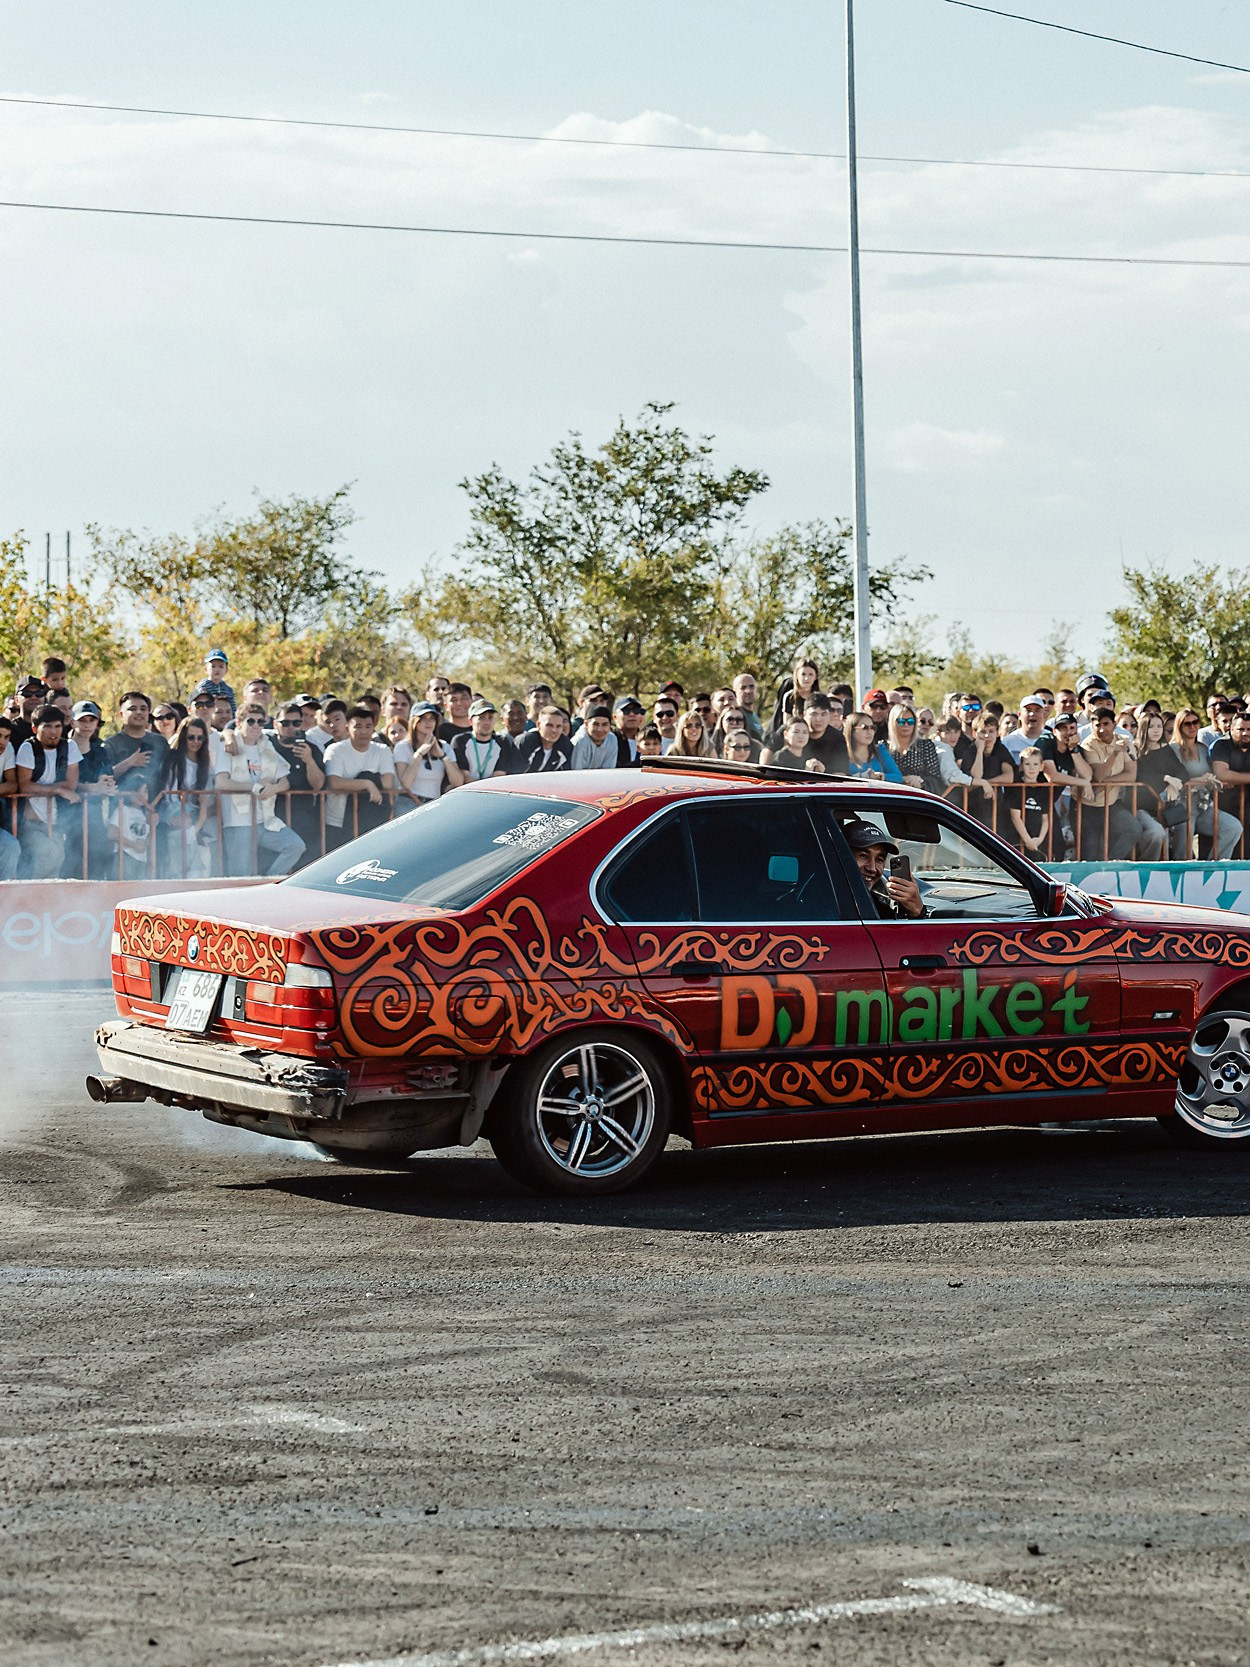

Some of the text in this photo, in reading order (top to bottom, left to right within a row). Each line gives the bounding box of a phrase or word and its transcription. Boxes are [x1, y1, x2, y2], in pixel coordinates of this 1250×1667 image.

[193, 973, 220, 999] 686
[169, 1002, 209, 1029] 07 AEM
[834, 967, 1090, 1047] market
